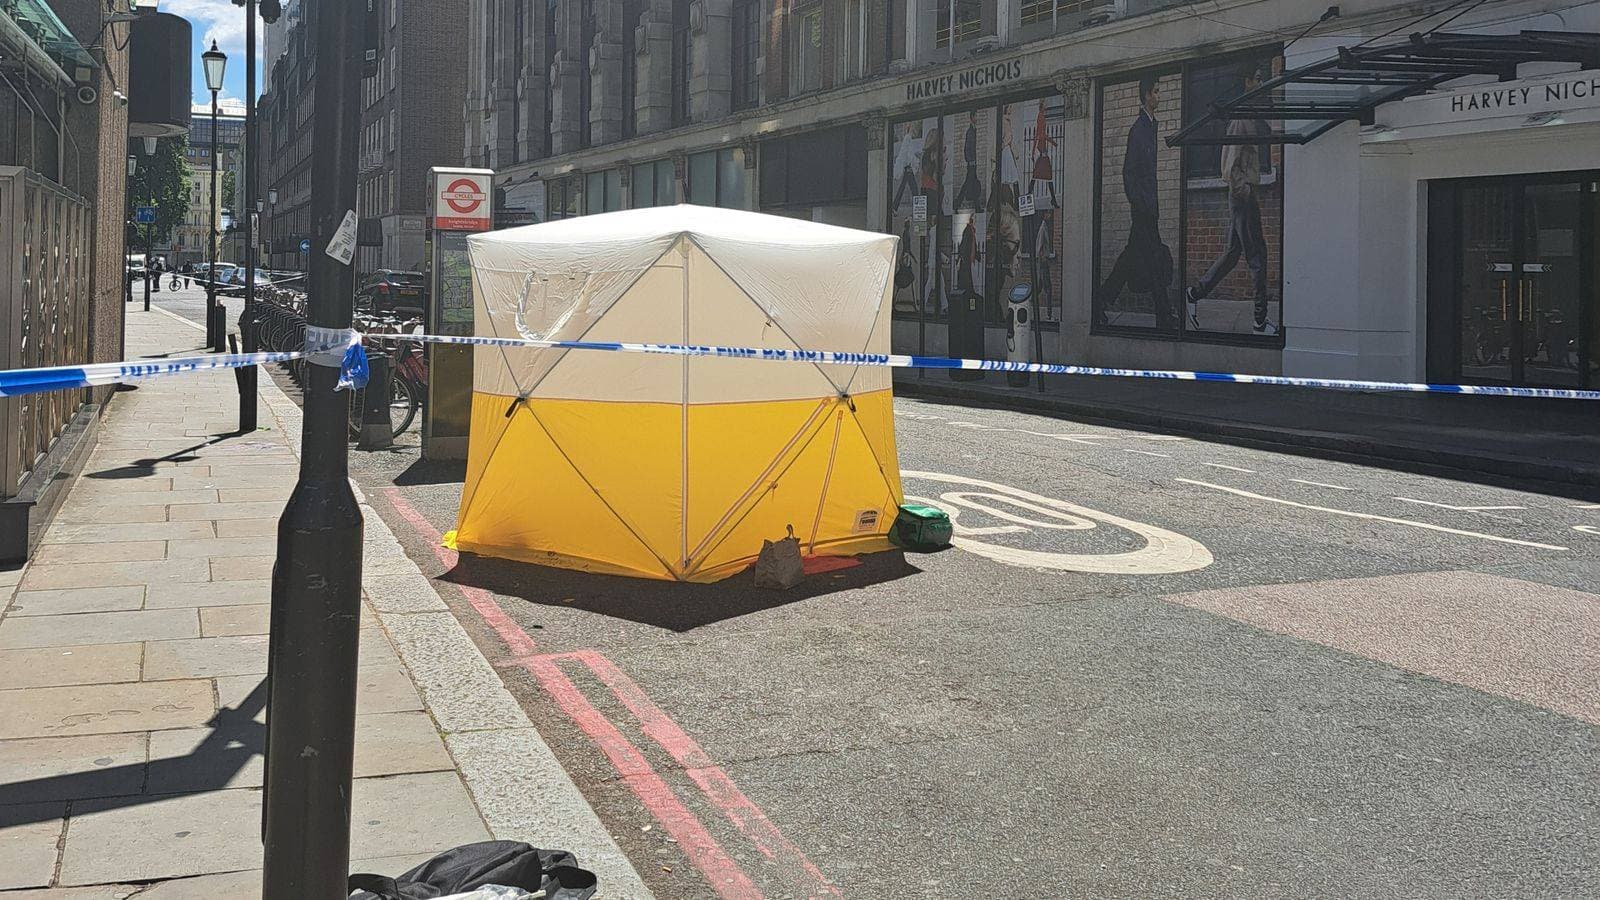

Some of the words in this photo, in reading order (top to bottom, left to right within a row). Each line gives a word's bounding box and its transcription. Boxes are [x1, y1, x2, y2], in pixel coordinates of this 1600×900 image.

[907, 75, 954, 100] HARVEY
[959, 60, 1021, 90] NICHOLS
[1451, 87, 1530, 112] HARVEY
